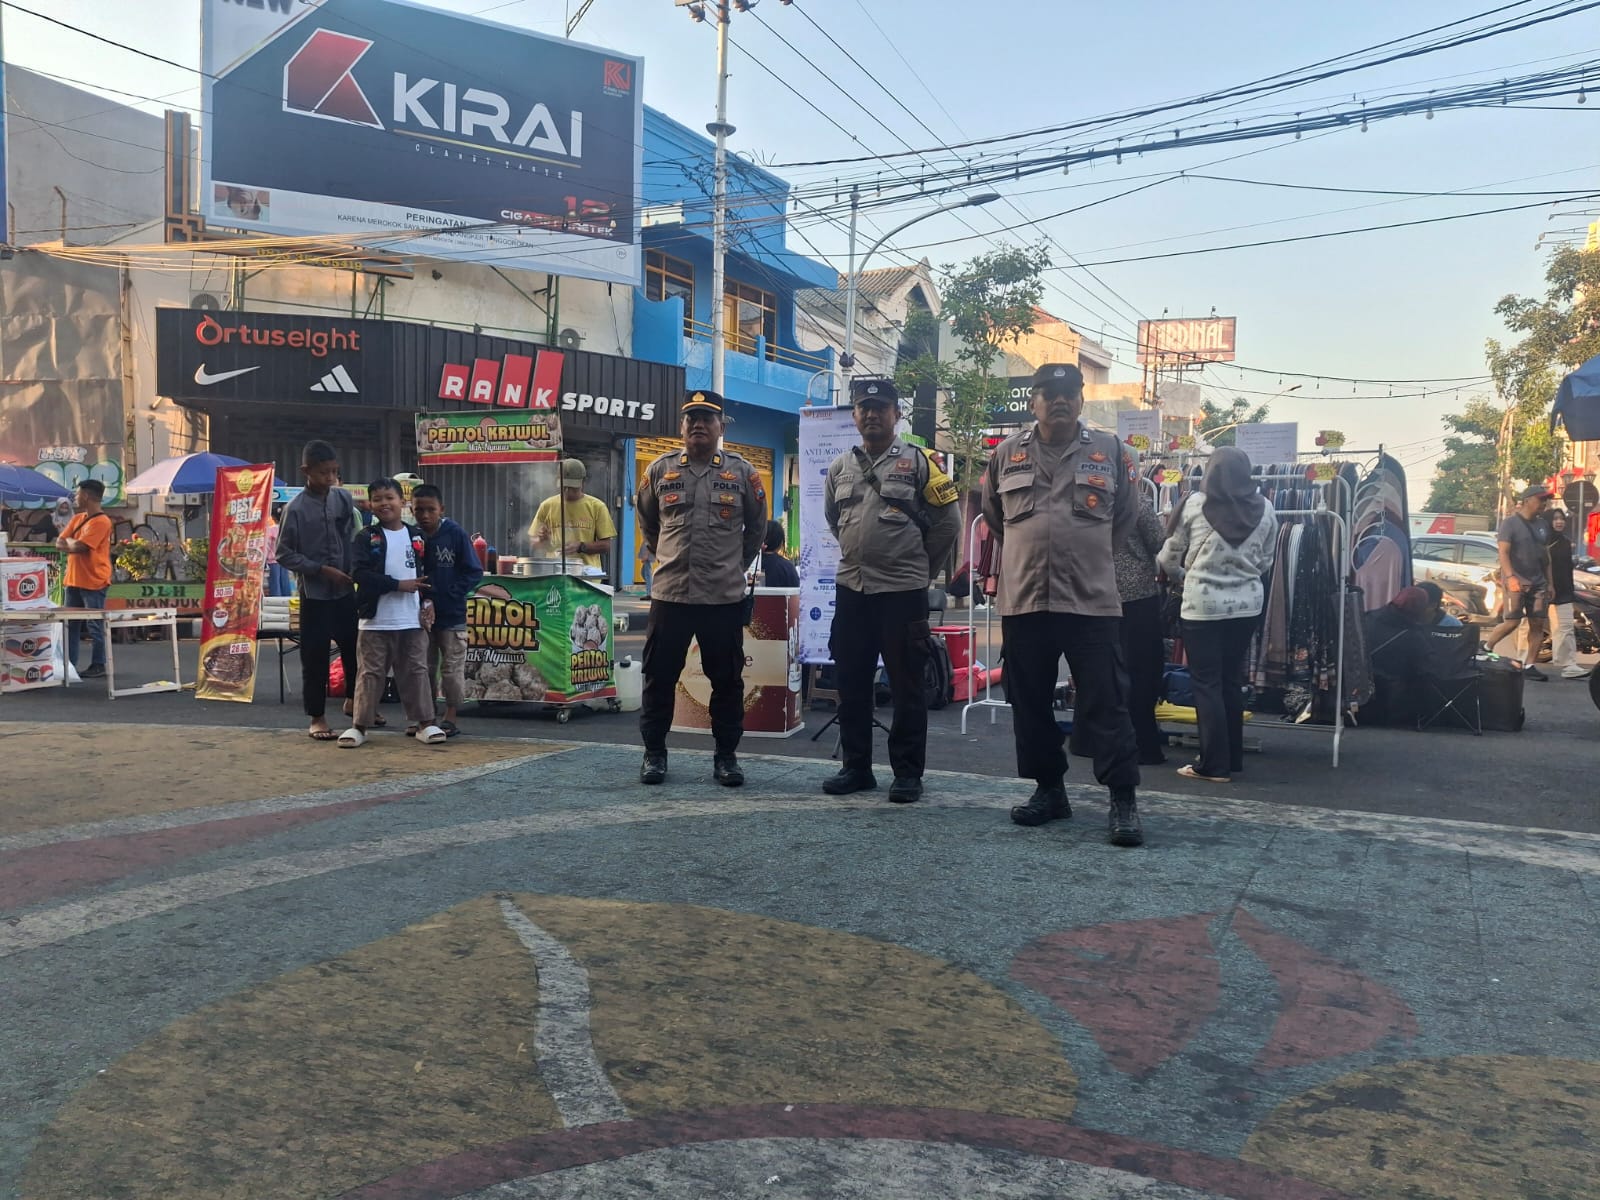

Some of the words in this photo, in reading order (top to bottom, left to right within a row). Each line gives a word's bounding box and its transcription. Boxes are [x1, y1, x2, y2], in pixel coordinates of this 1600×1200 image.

[393, 72, 583, 158] KIRAI
[405, 212, 467, 228] PERINGATAN
[337, 214, 367, 223] KARENA
[367, 217, 403, 228] MEROKOK
[486, 233, 535, 249] TNGGOROKAN
[1142, 321, 1229, 352] CARDINAL
[444, 375, 553, 408] RANK
[561, 392, 656, 421] SPORTS
[427, 426, 486, 444] PENTOL
[713, 482, 740, 490] POLRI
[230, 496, 255, 515] BEST
[236, 509, 262, 523] SELLER
[141, 585, 186, 597] DLH
[126, 598, 200, 608] NGANJUK
[465, 598, 537, 627] ENTOL
[466, 626, 536, 647] RIWUL
[571, 650, 609, 669] PENTOL
